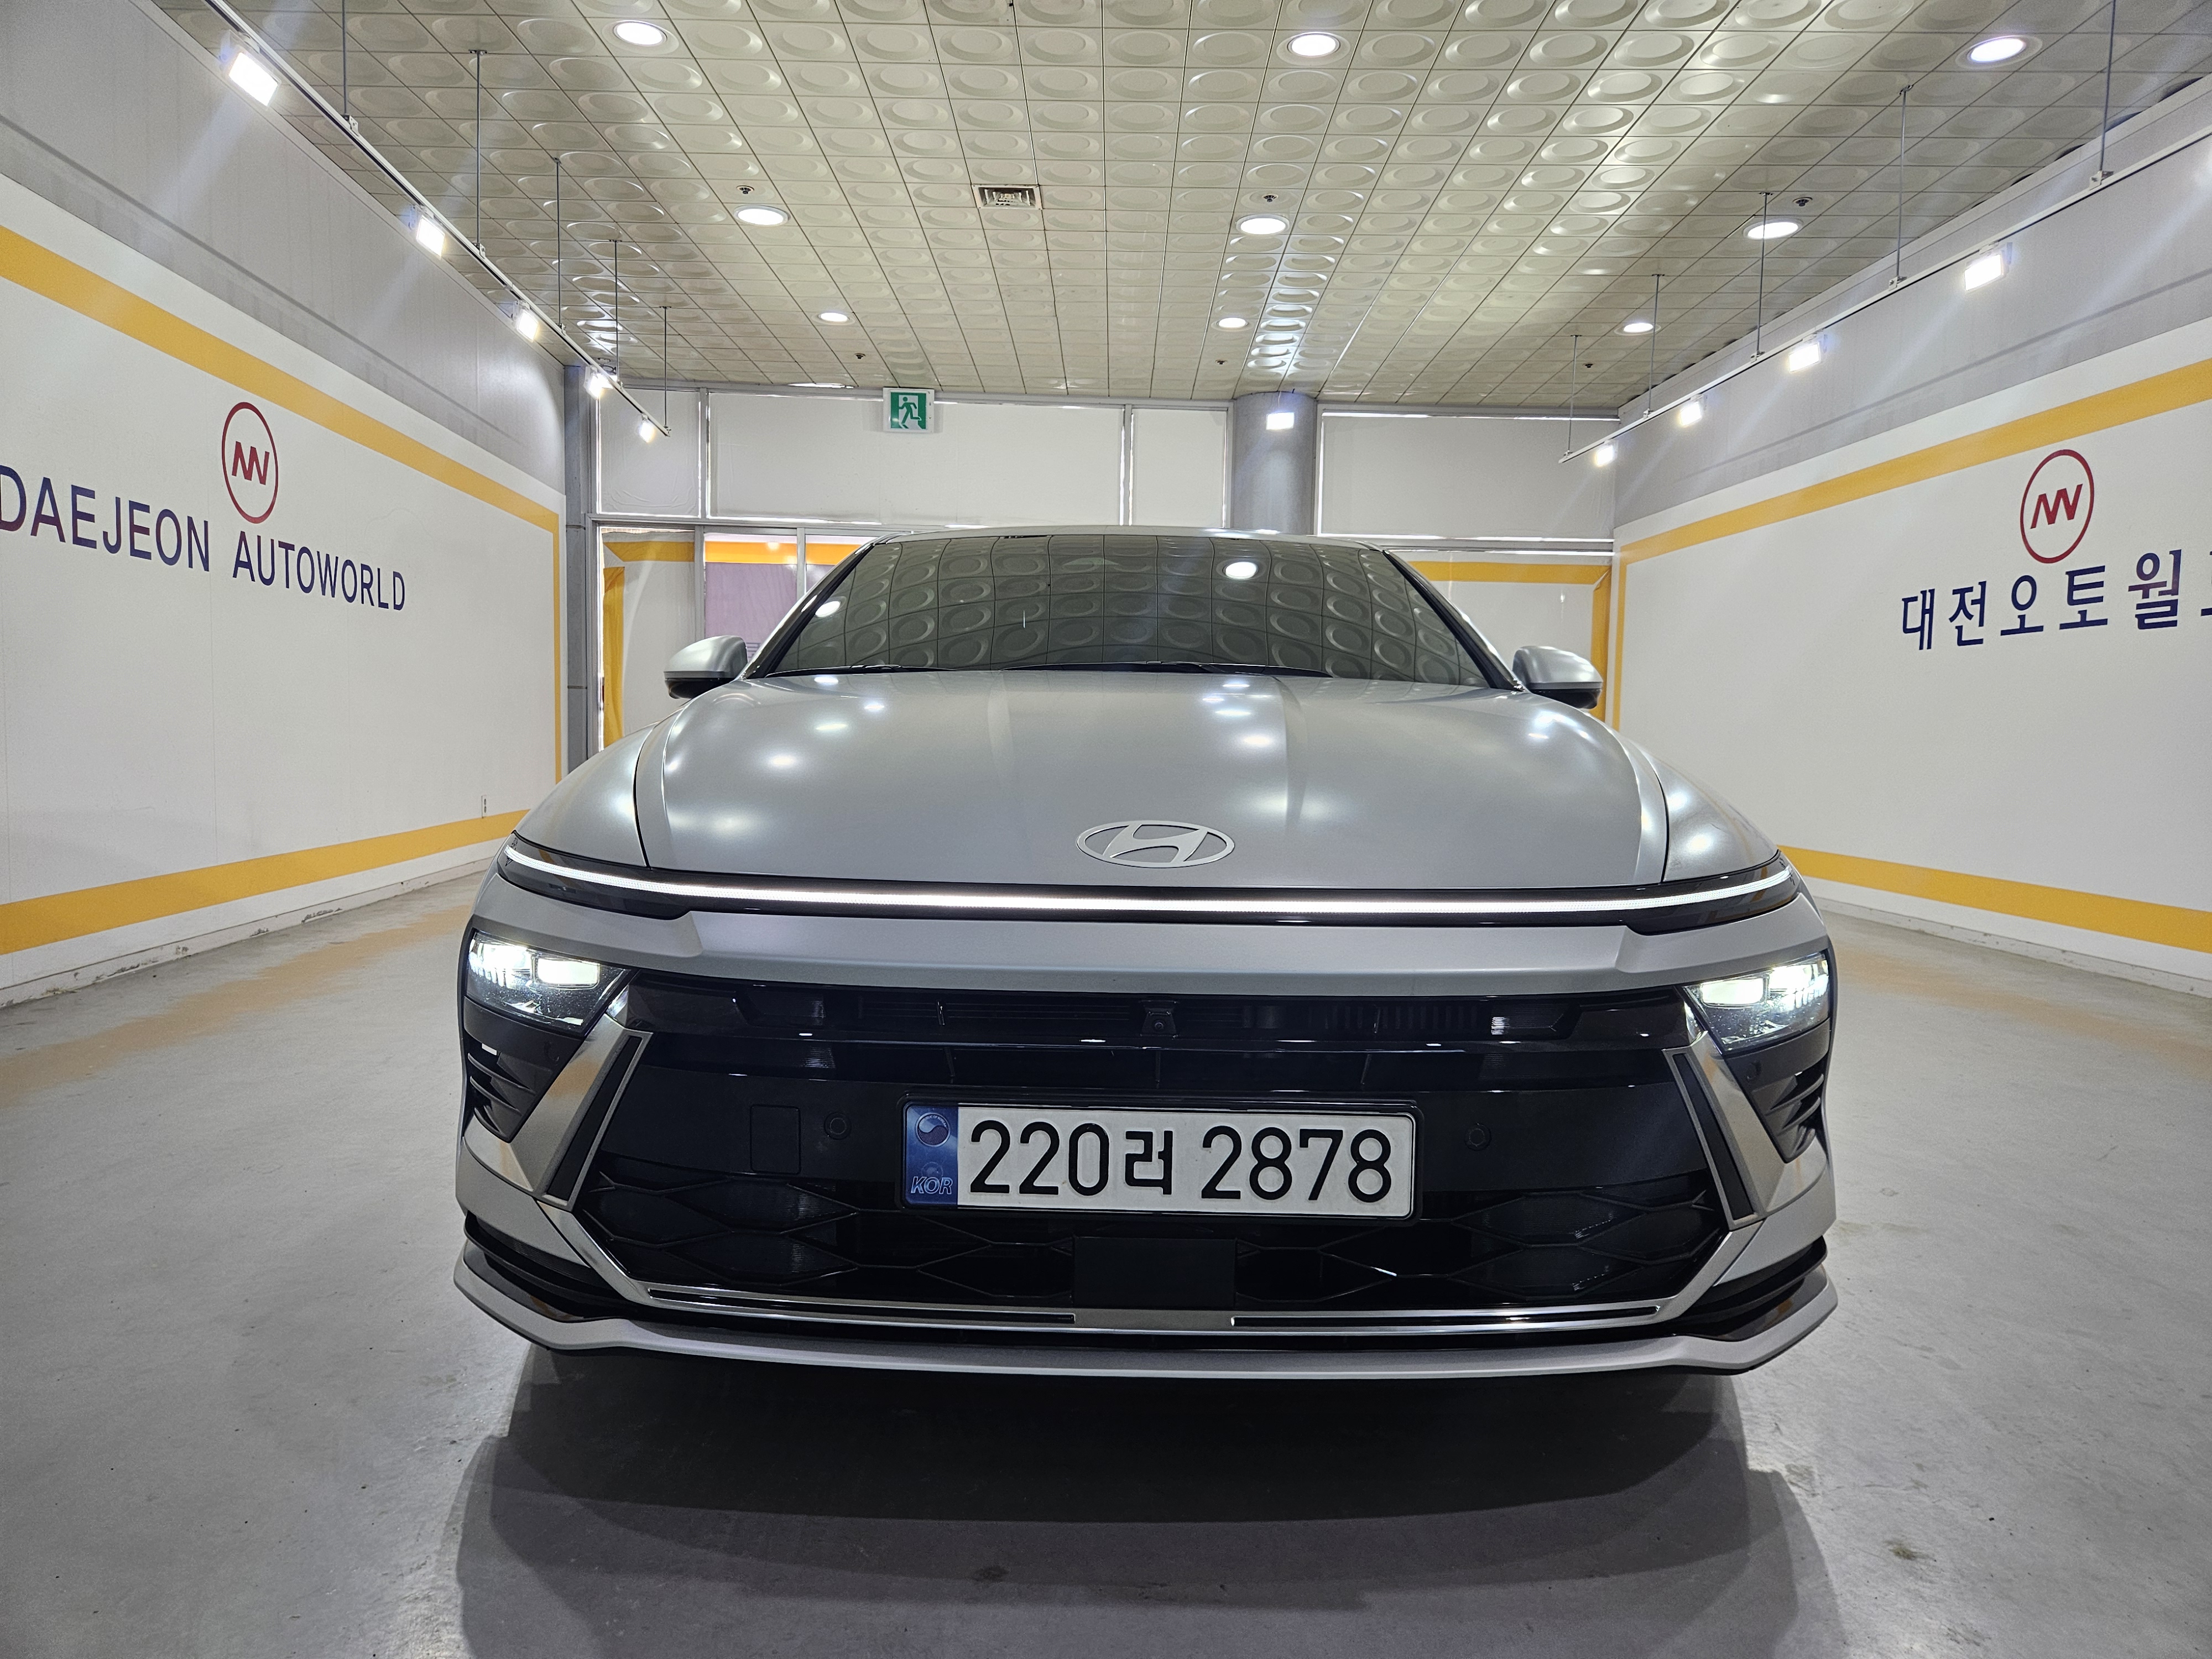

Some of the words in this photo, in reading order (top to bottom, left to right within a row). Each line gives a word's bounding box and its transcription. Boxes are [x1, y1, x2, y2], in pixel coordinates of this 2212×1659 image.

[0, 465, 210, 572] DAEJEON
[232, 531, 405, 611] AUTOWORLD
[1901, 549, 2212, 650] 대전오토월
[910, 1176, 953, 1195] KOR
[1201, 1126, 1392, 1203] 2878
